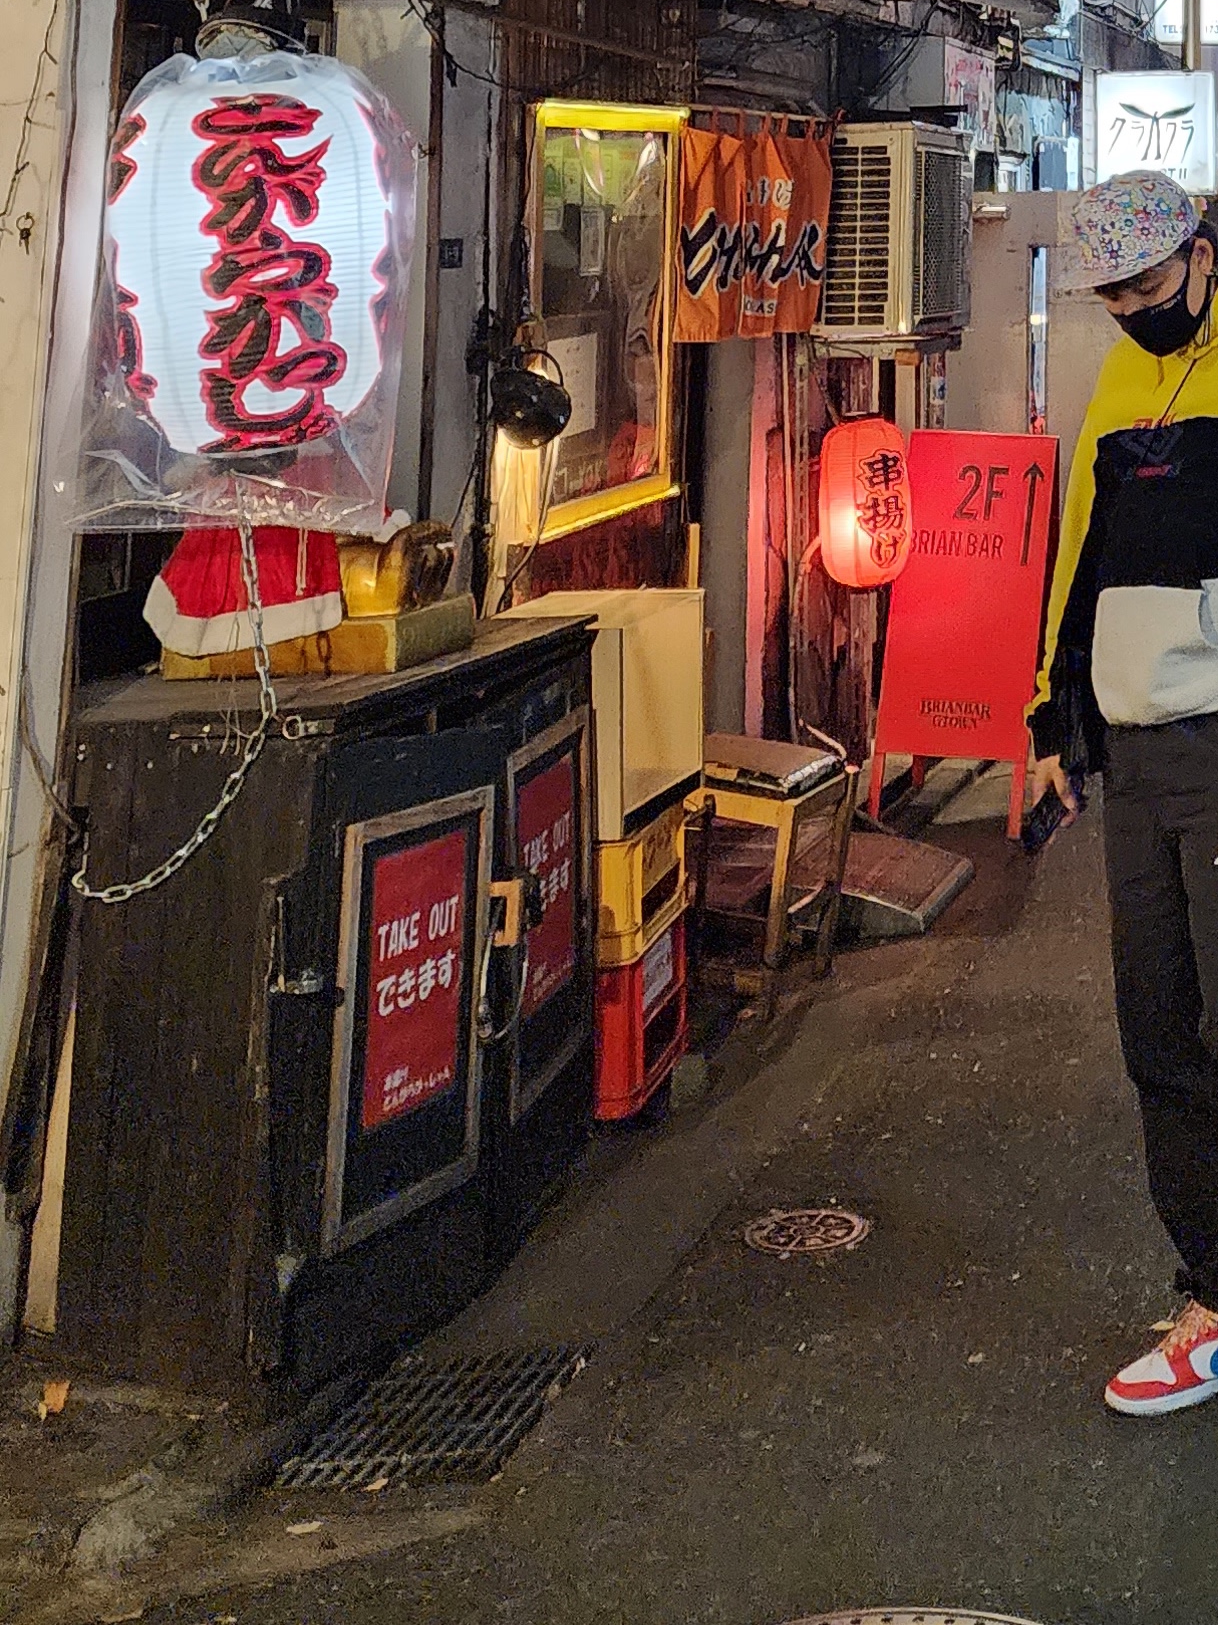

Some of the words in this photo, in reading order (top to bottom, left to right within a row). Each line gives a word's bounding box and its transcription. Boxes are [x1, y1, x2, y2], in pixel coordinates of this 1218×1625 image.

[857, 446, 907, 570] 串揚げ
[952, 463, 1009, 522] 2F
[909, 528, 962, 560] BRIAN
[965, 531, 1005, 560] BAR
[377, 911, 421, 962] TAKE
[428, 894, 460, 941] OUT
[376, 948, 456, 1017] できます
